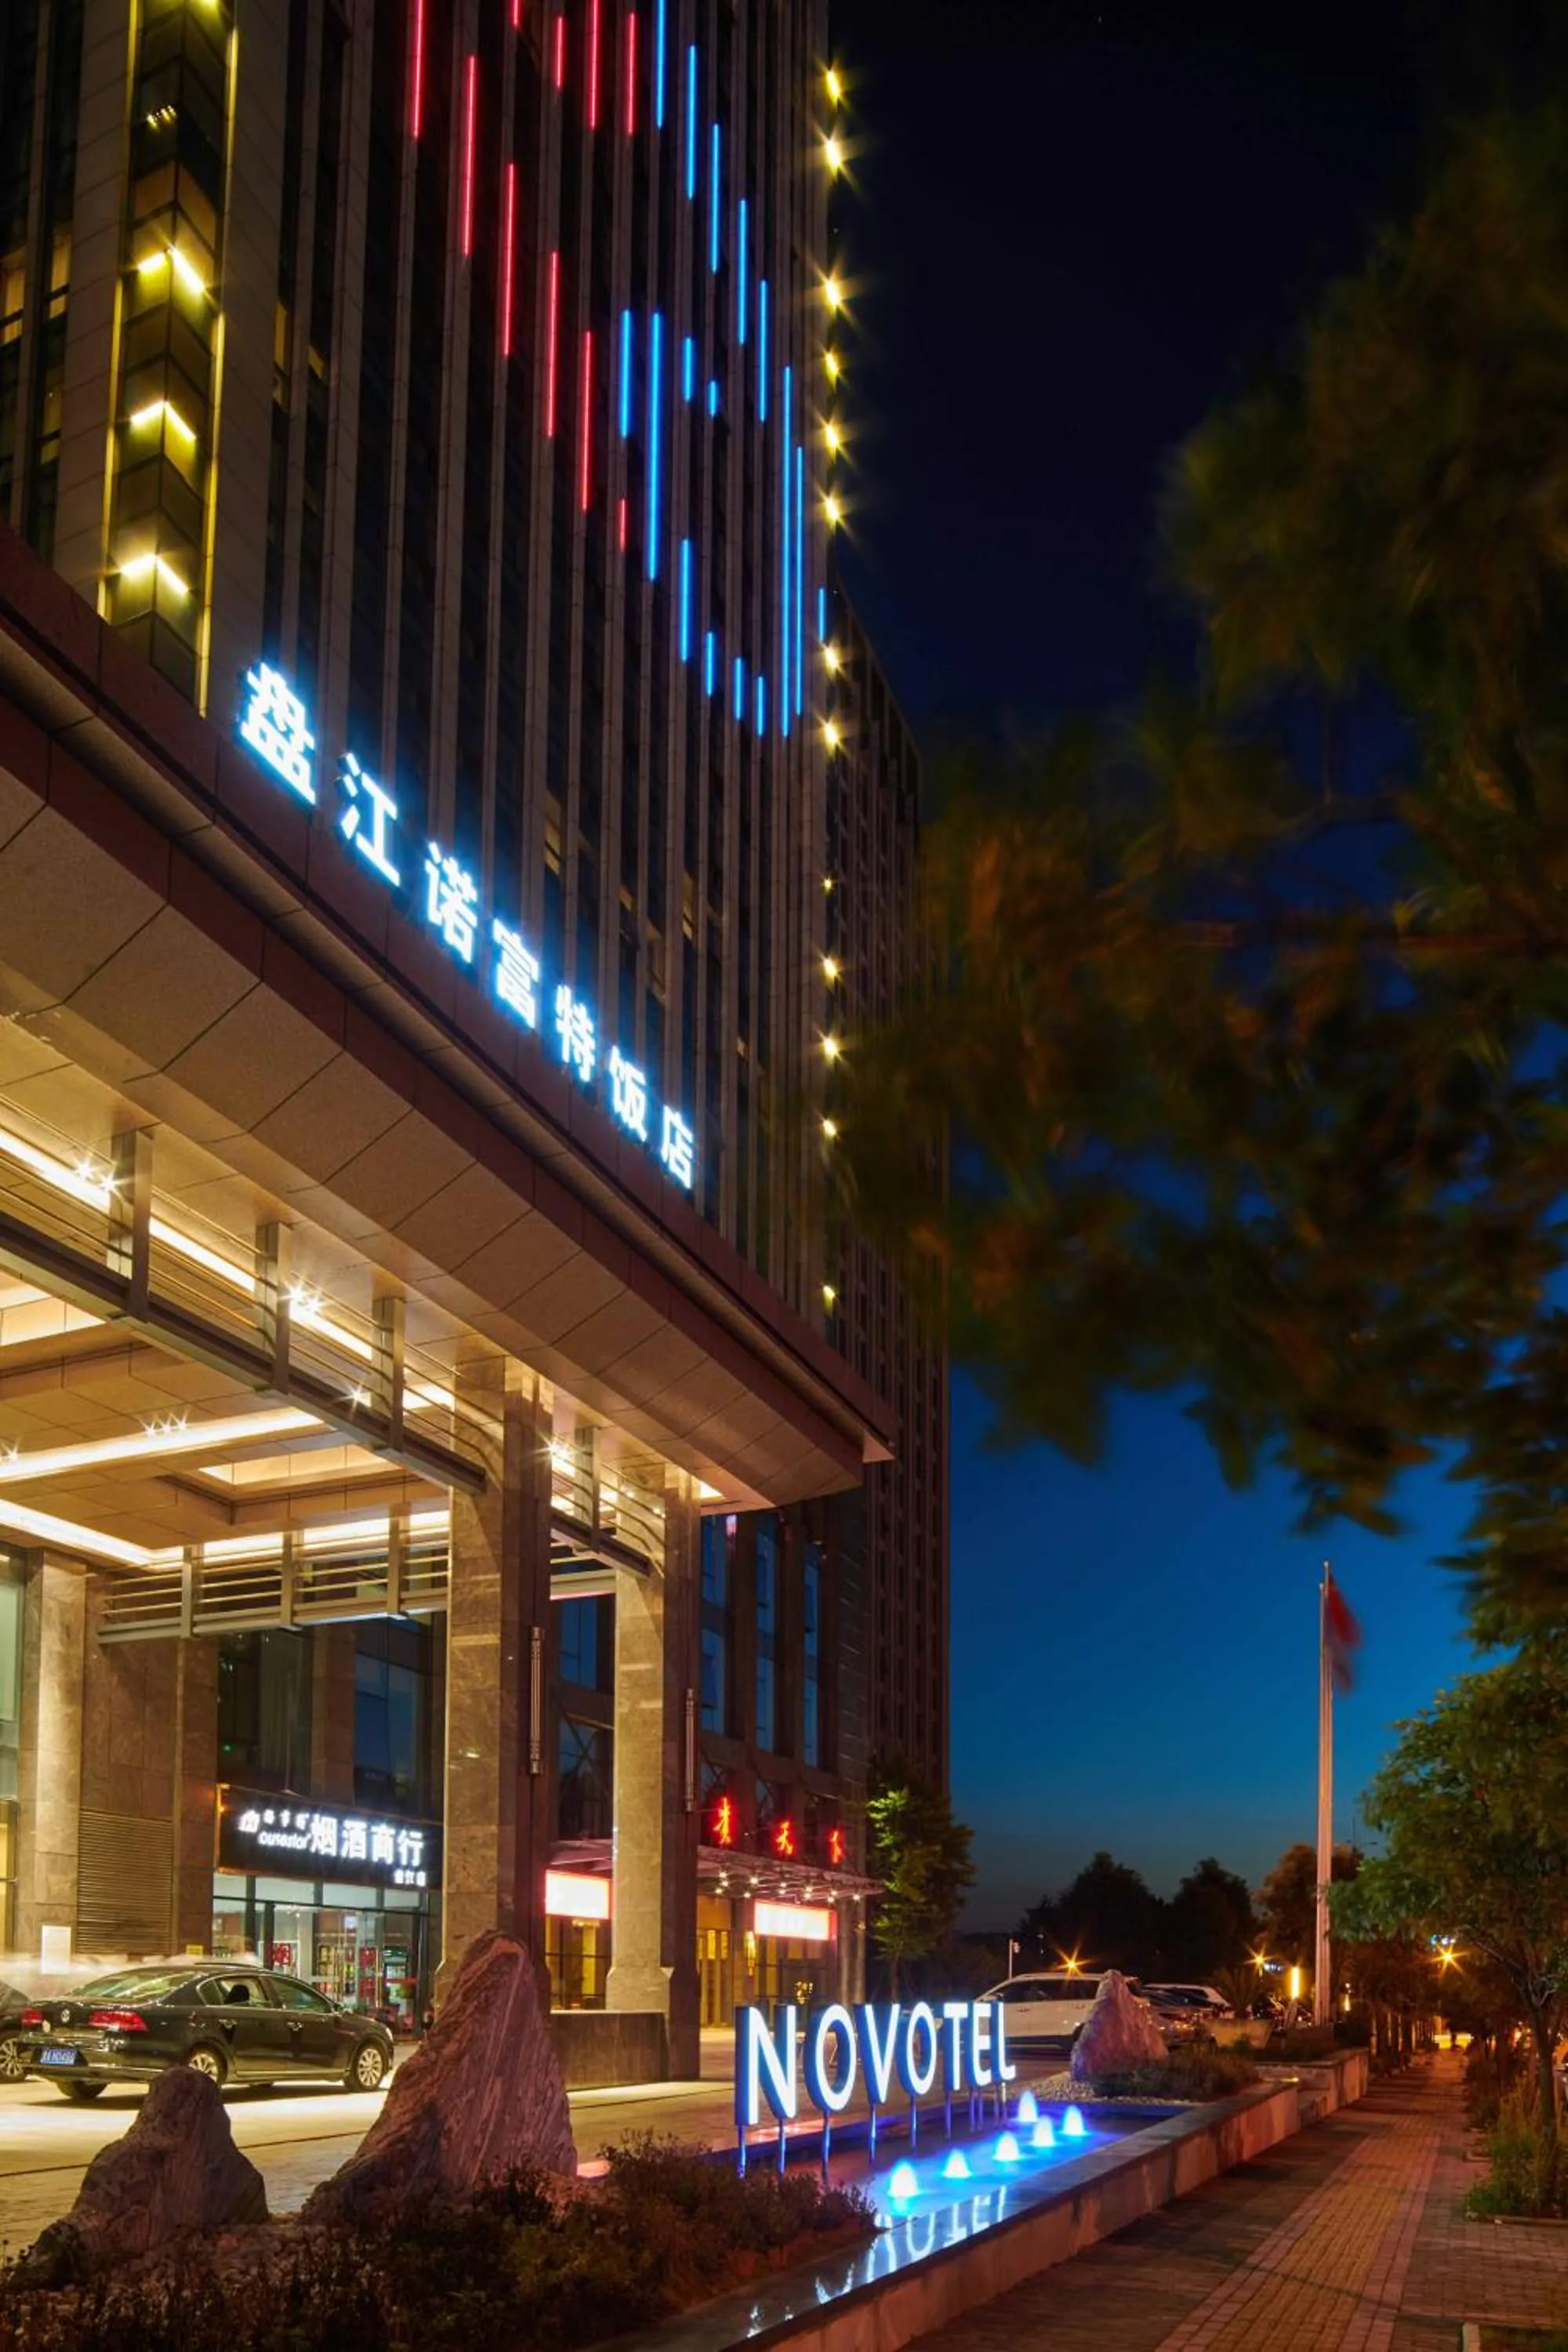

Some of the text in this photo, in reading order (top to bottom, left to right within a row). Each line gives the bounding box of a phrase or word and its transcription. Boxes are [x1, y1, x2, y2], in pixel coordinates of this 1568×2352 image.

[240, 663, 694, 1189] 盘江诺富特饭店
[310, 1813, 424, 1867] 烟酒商行
[737, 2000, 1016, 2125] NOVOTEL
